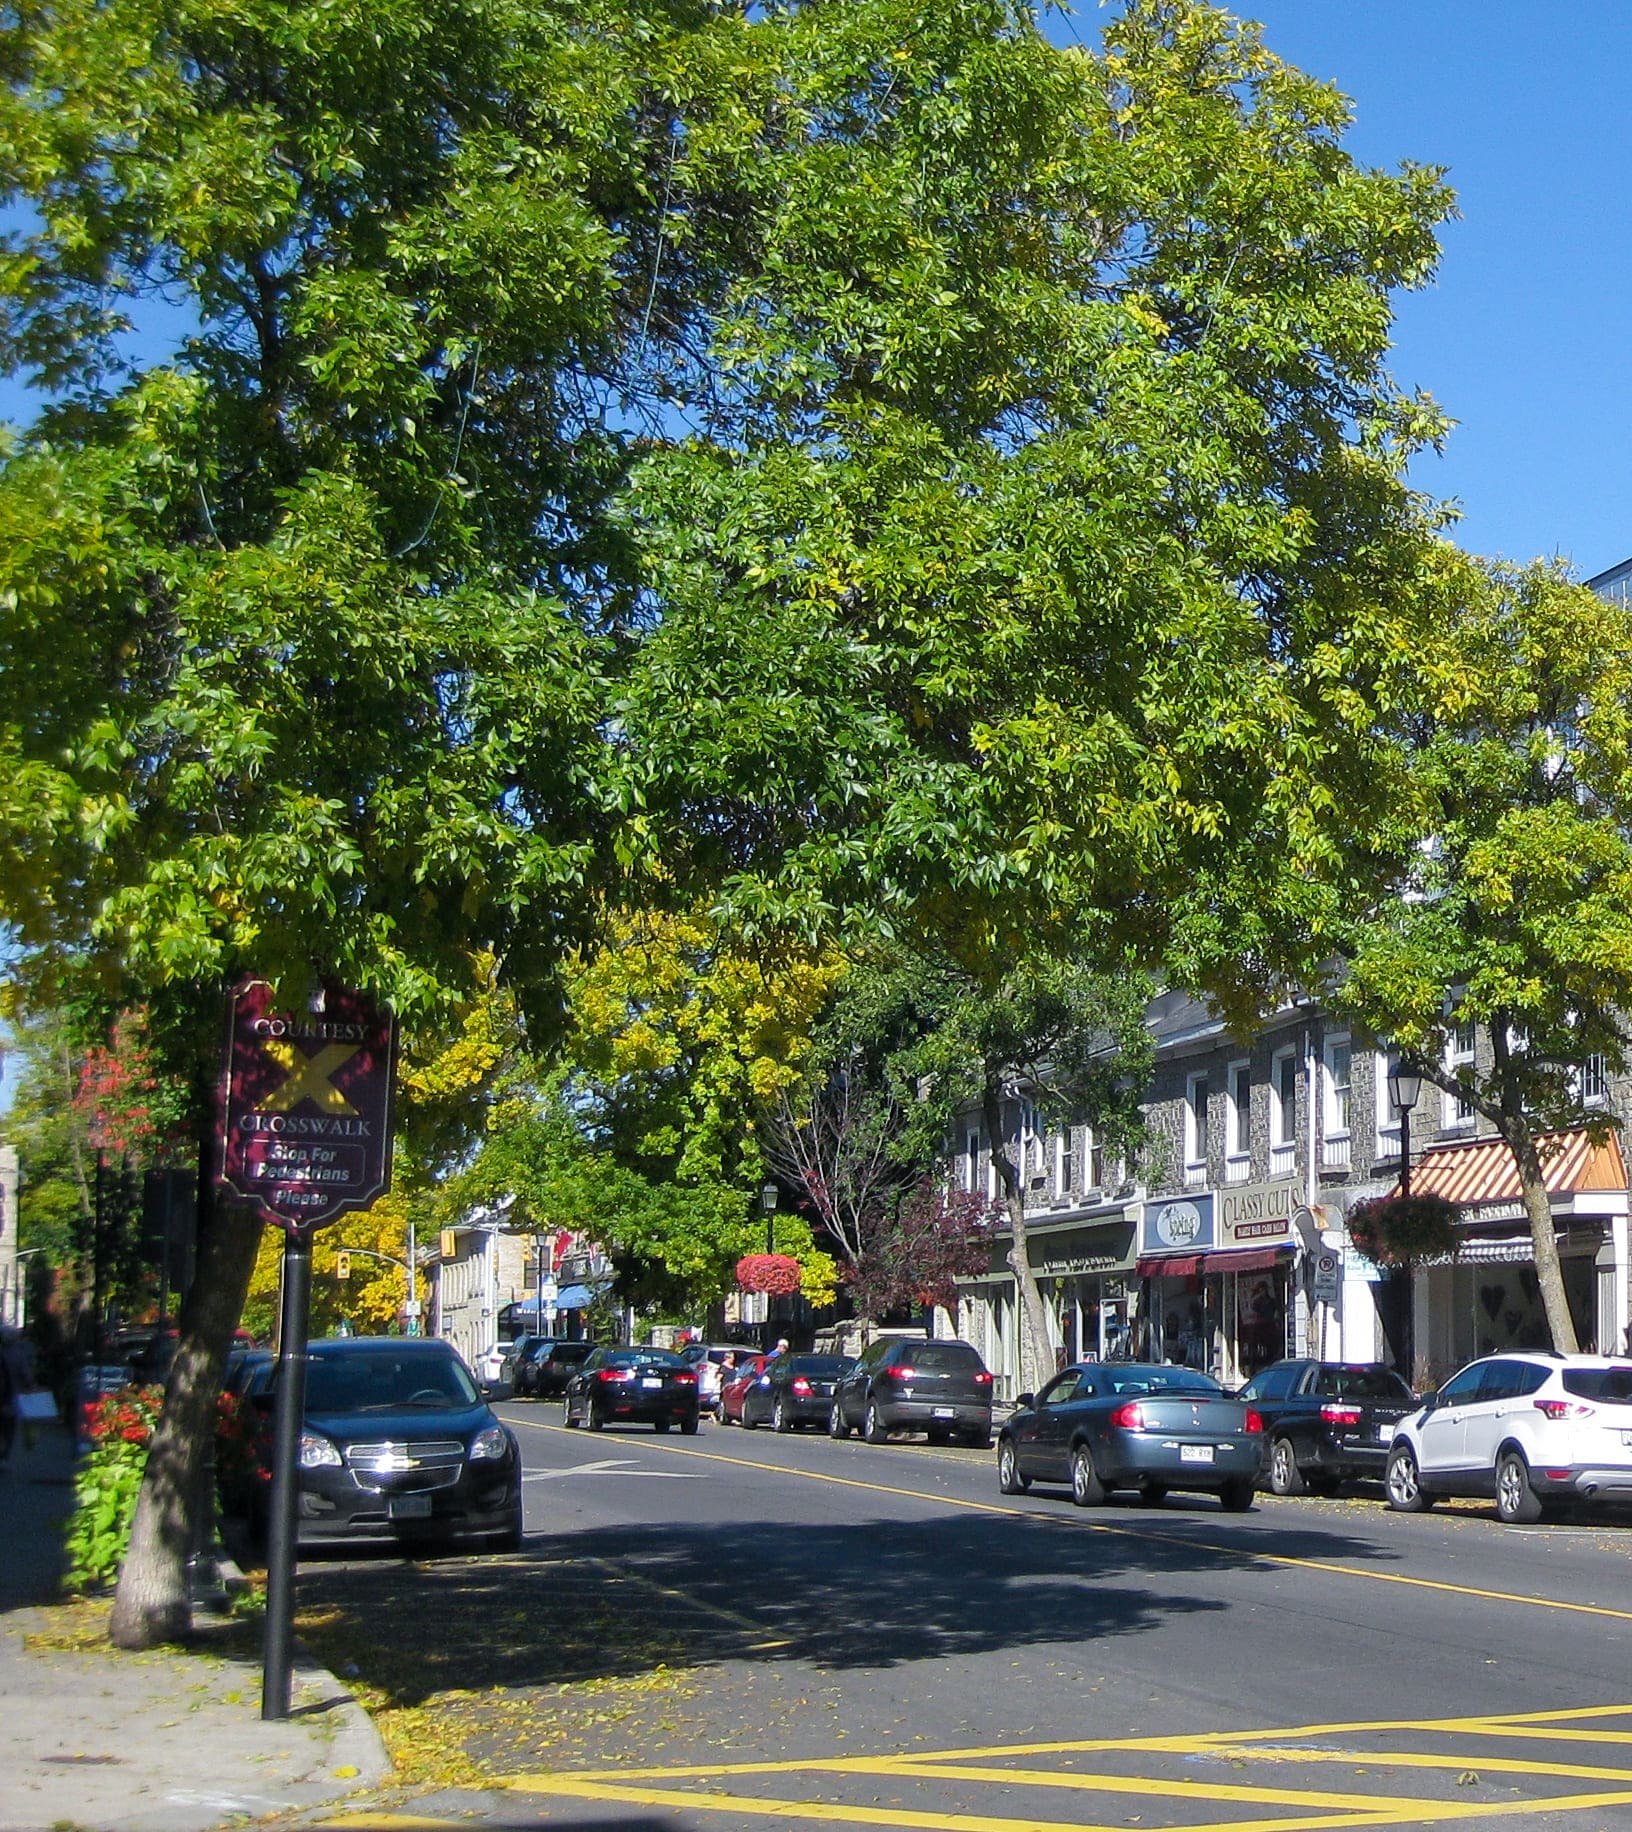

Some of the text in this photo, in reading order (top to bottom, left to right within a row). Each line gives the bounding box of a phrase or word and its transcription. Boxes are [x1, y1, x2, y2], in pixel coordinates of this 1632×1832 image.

[253, 1018, 369, 1040] COURTESY
[240, 1114, 372, 1137] CROSSWALK
[271, 1144, 337, 1162] Stop For
[256, 1162, 350, 1182] Pedestrians
[275, 1188, 329, 1206] Please
[1223, 1192, 1265, 1230] CLASSY
